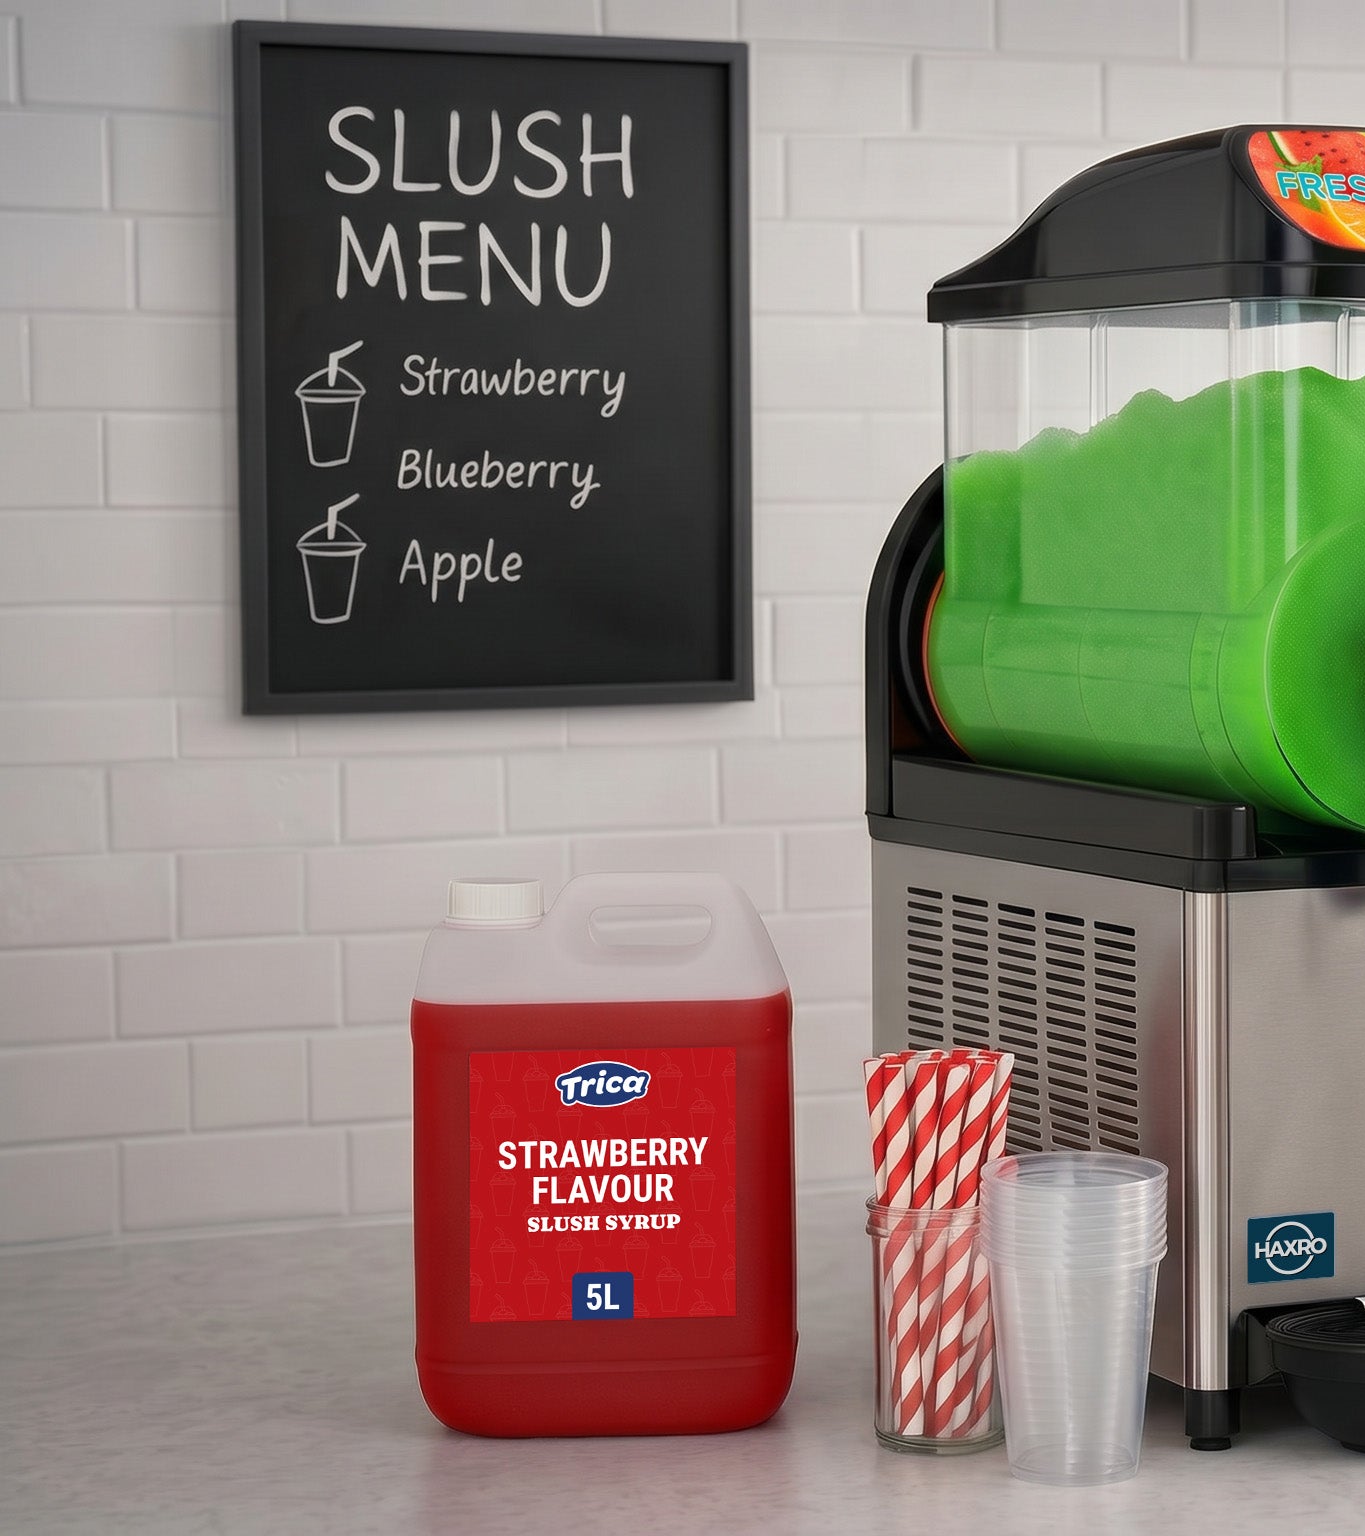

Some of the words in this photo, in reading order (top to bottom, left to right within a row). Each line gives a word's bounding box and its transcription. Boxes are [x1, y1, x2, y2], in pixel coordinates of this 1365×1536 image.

[325, 105, 635, 199] SLUSH
[336, 215, 612, 308] MENU
[399, 354, 626, 418] Strawberry
[397, 448, 601, 510] Blueberry
[399, 537, 523, 603] Apple
[561, 1069, 646, 1100] Trica
[498, 1136, 709, 1170] STRAWBERRY
[532, 1173, 674, 1205] FLAVOUR
[527, 1215, 600, 1233] SLUSH
[605, 1213, 681, 1231] SYRUP
[1254, 1237, 1328, 1260] HAXRO
[586, 1282, 620, 1311] 5L
